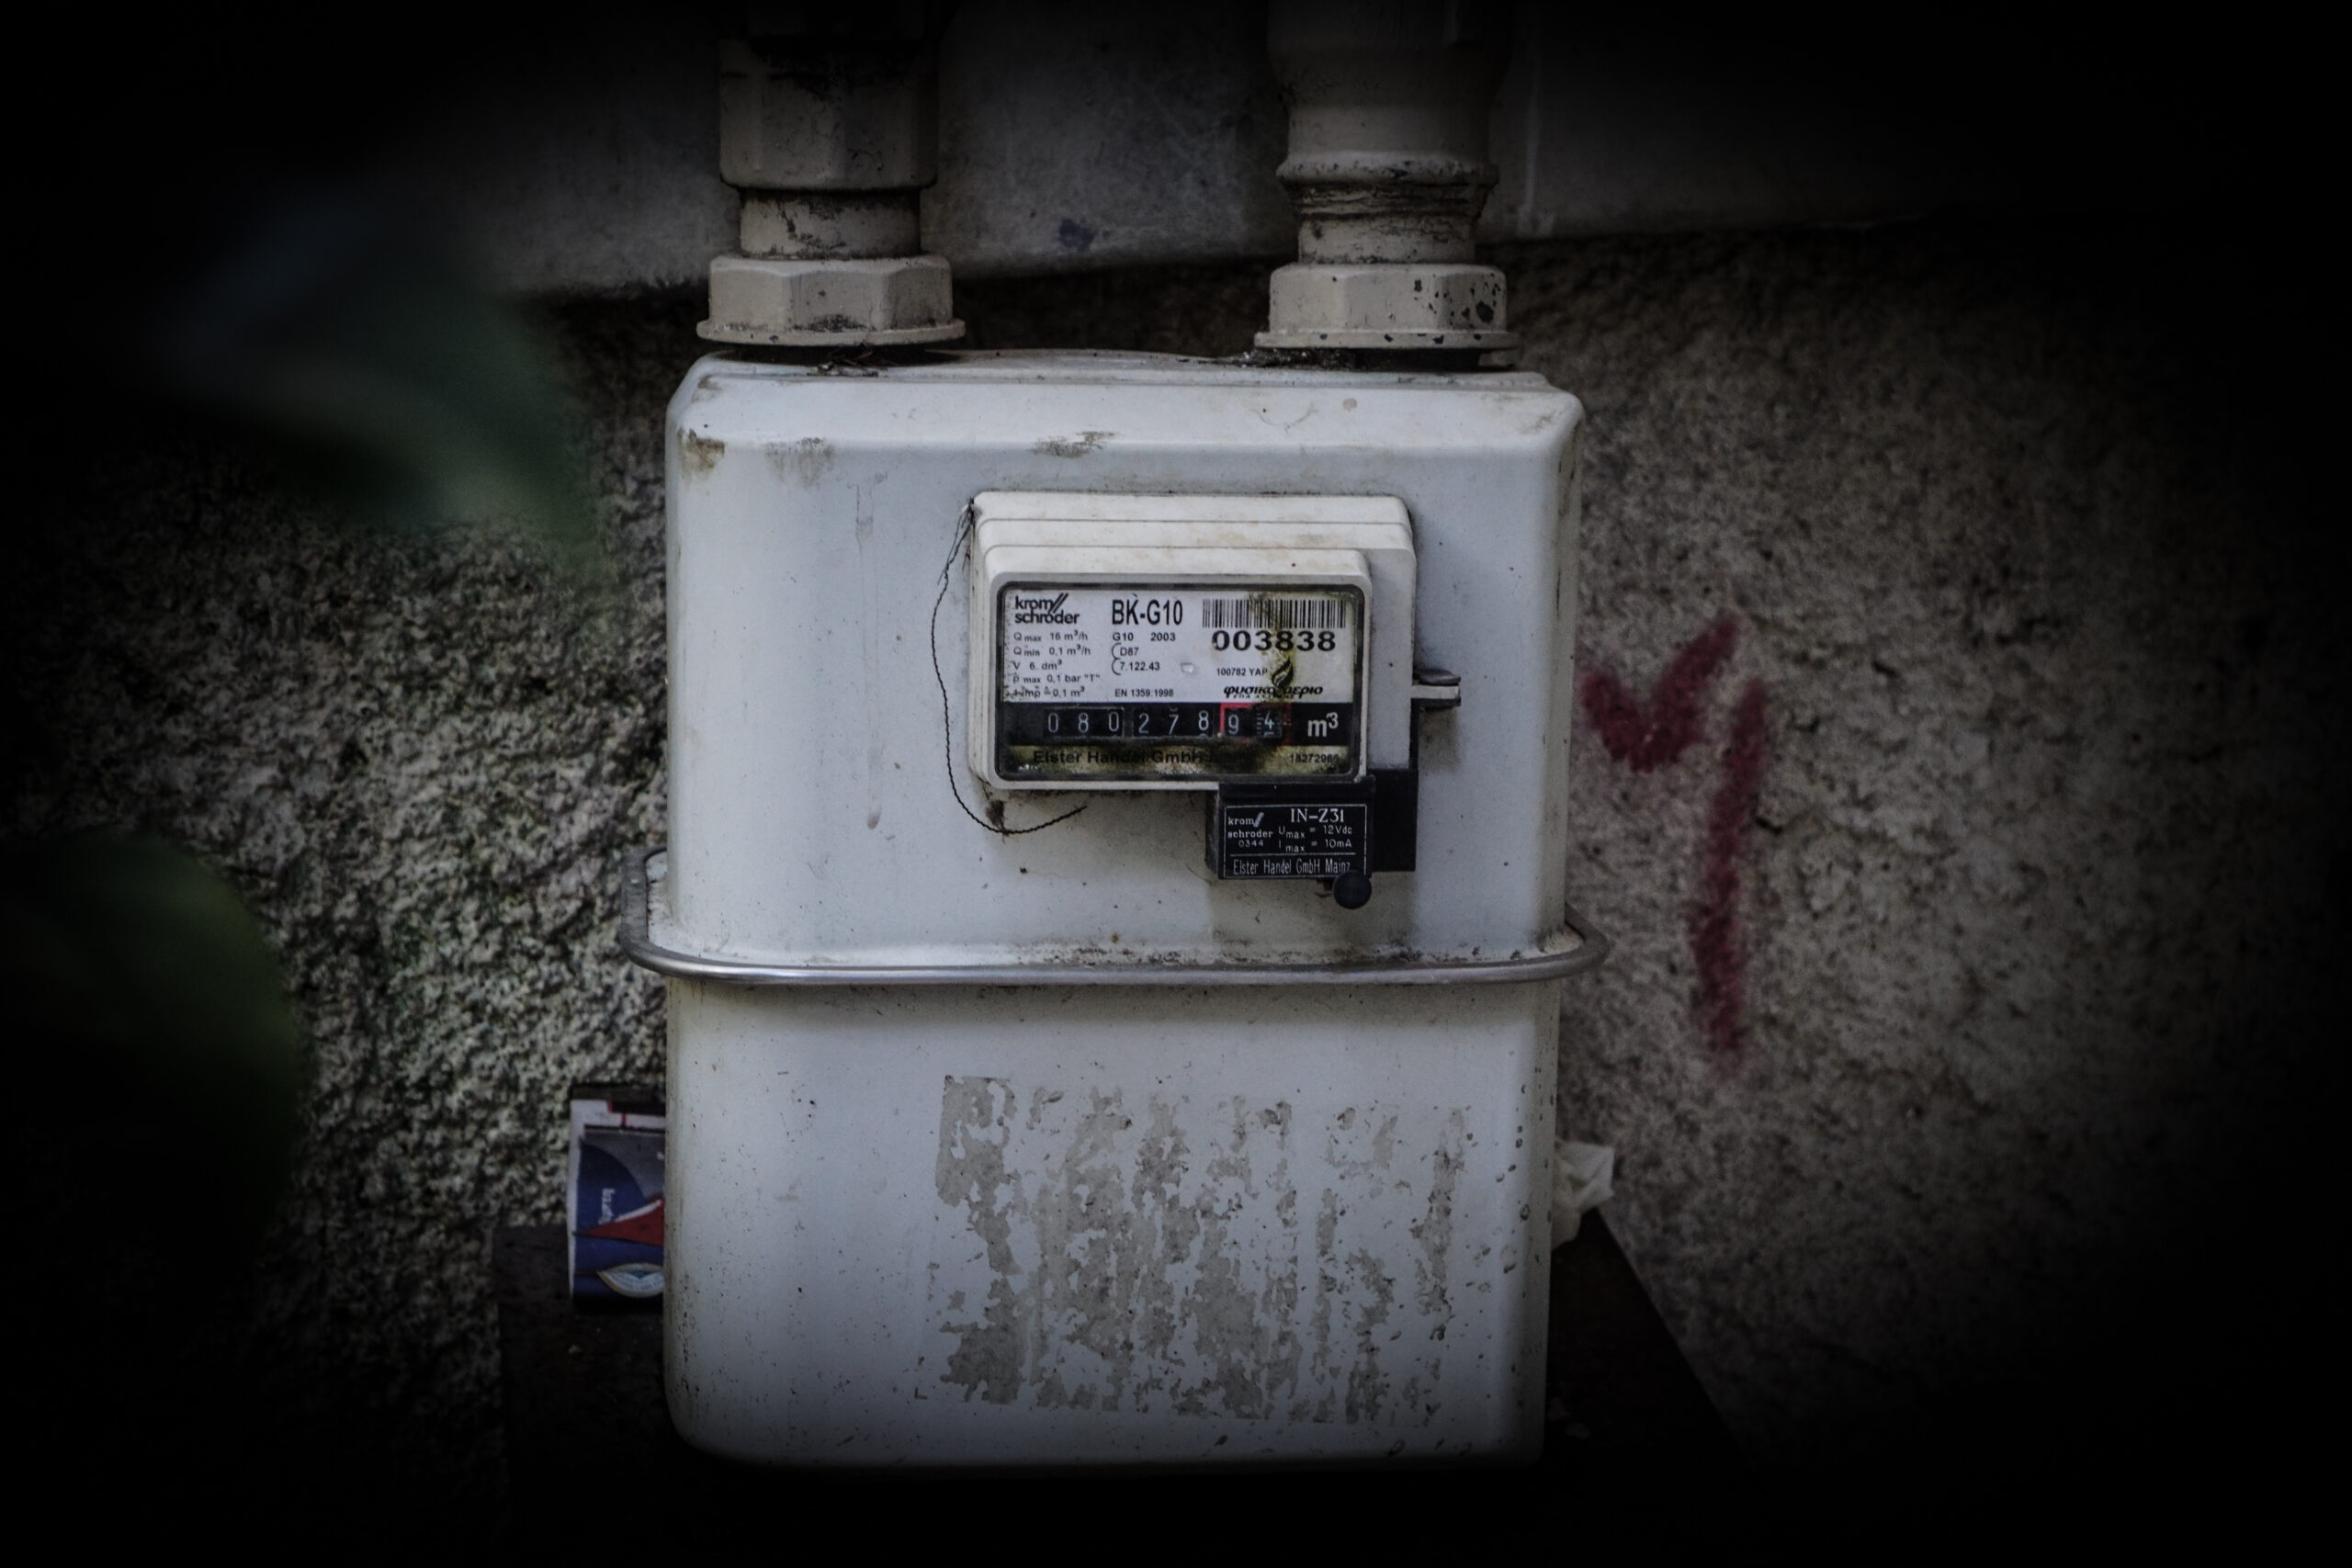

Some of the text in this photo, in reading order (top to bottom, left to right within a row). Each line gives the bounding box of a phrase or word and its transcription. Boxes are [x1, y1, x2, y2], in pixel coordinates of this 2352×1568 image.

[1112, 599, 1183, 626] BK-G10
[1113, 632, 1176, 641] G10 2003
[1212, 630, 1336, 651] 003838
[1216, 668, 1246, 676] 100782
[1065, 673, 1080, 682] bar
[1114, 689, 1127, 697] EN
[1033, 750, 1081, 764] Elster
[1238, 840, 1263, 848] 0344
[1233, 859, 1259, 875] Elster
[1263, 858, 1292, 874] Handel
[1296, 858, 1320, 874] GmbH
